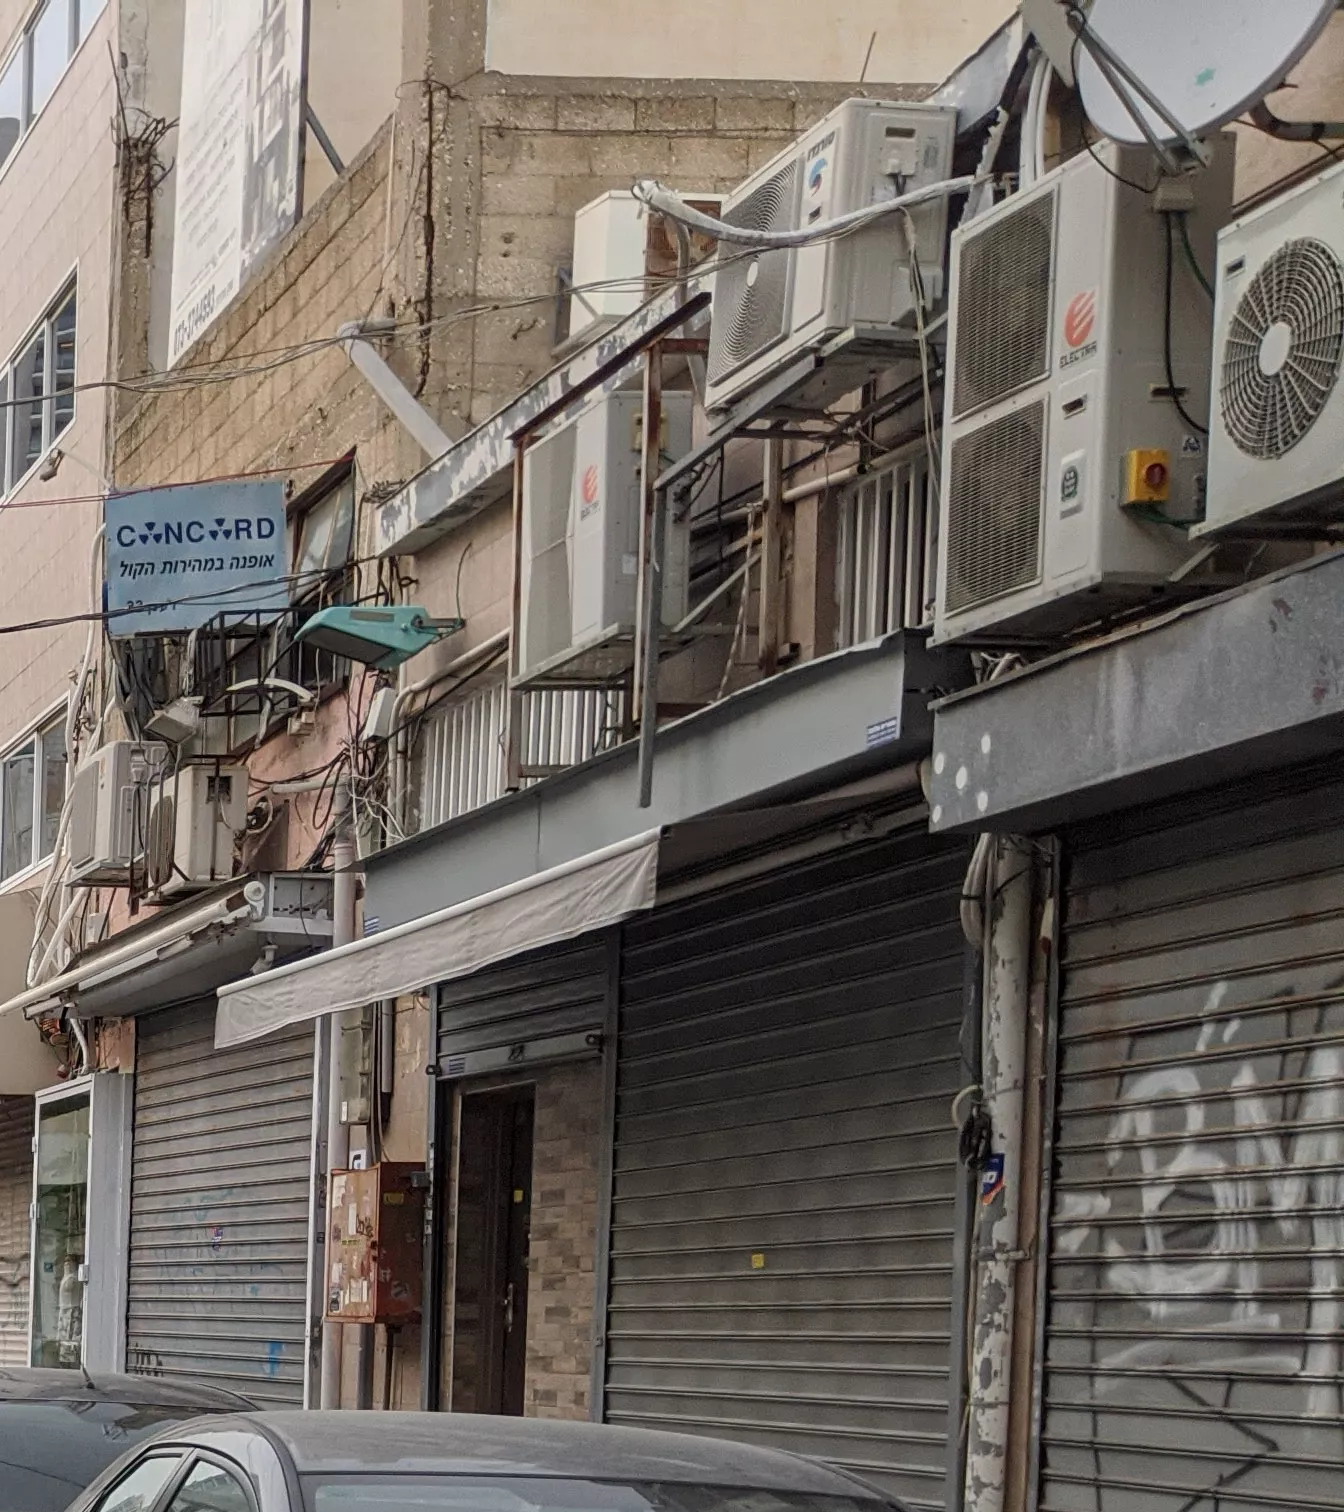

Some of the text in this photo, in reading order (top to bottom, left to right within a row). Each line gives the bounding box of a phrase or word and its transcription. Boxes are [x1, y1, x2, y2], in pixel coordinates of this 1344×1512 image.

[120, 554, 274, 580] אופנה במהירות הקול
